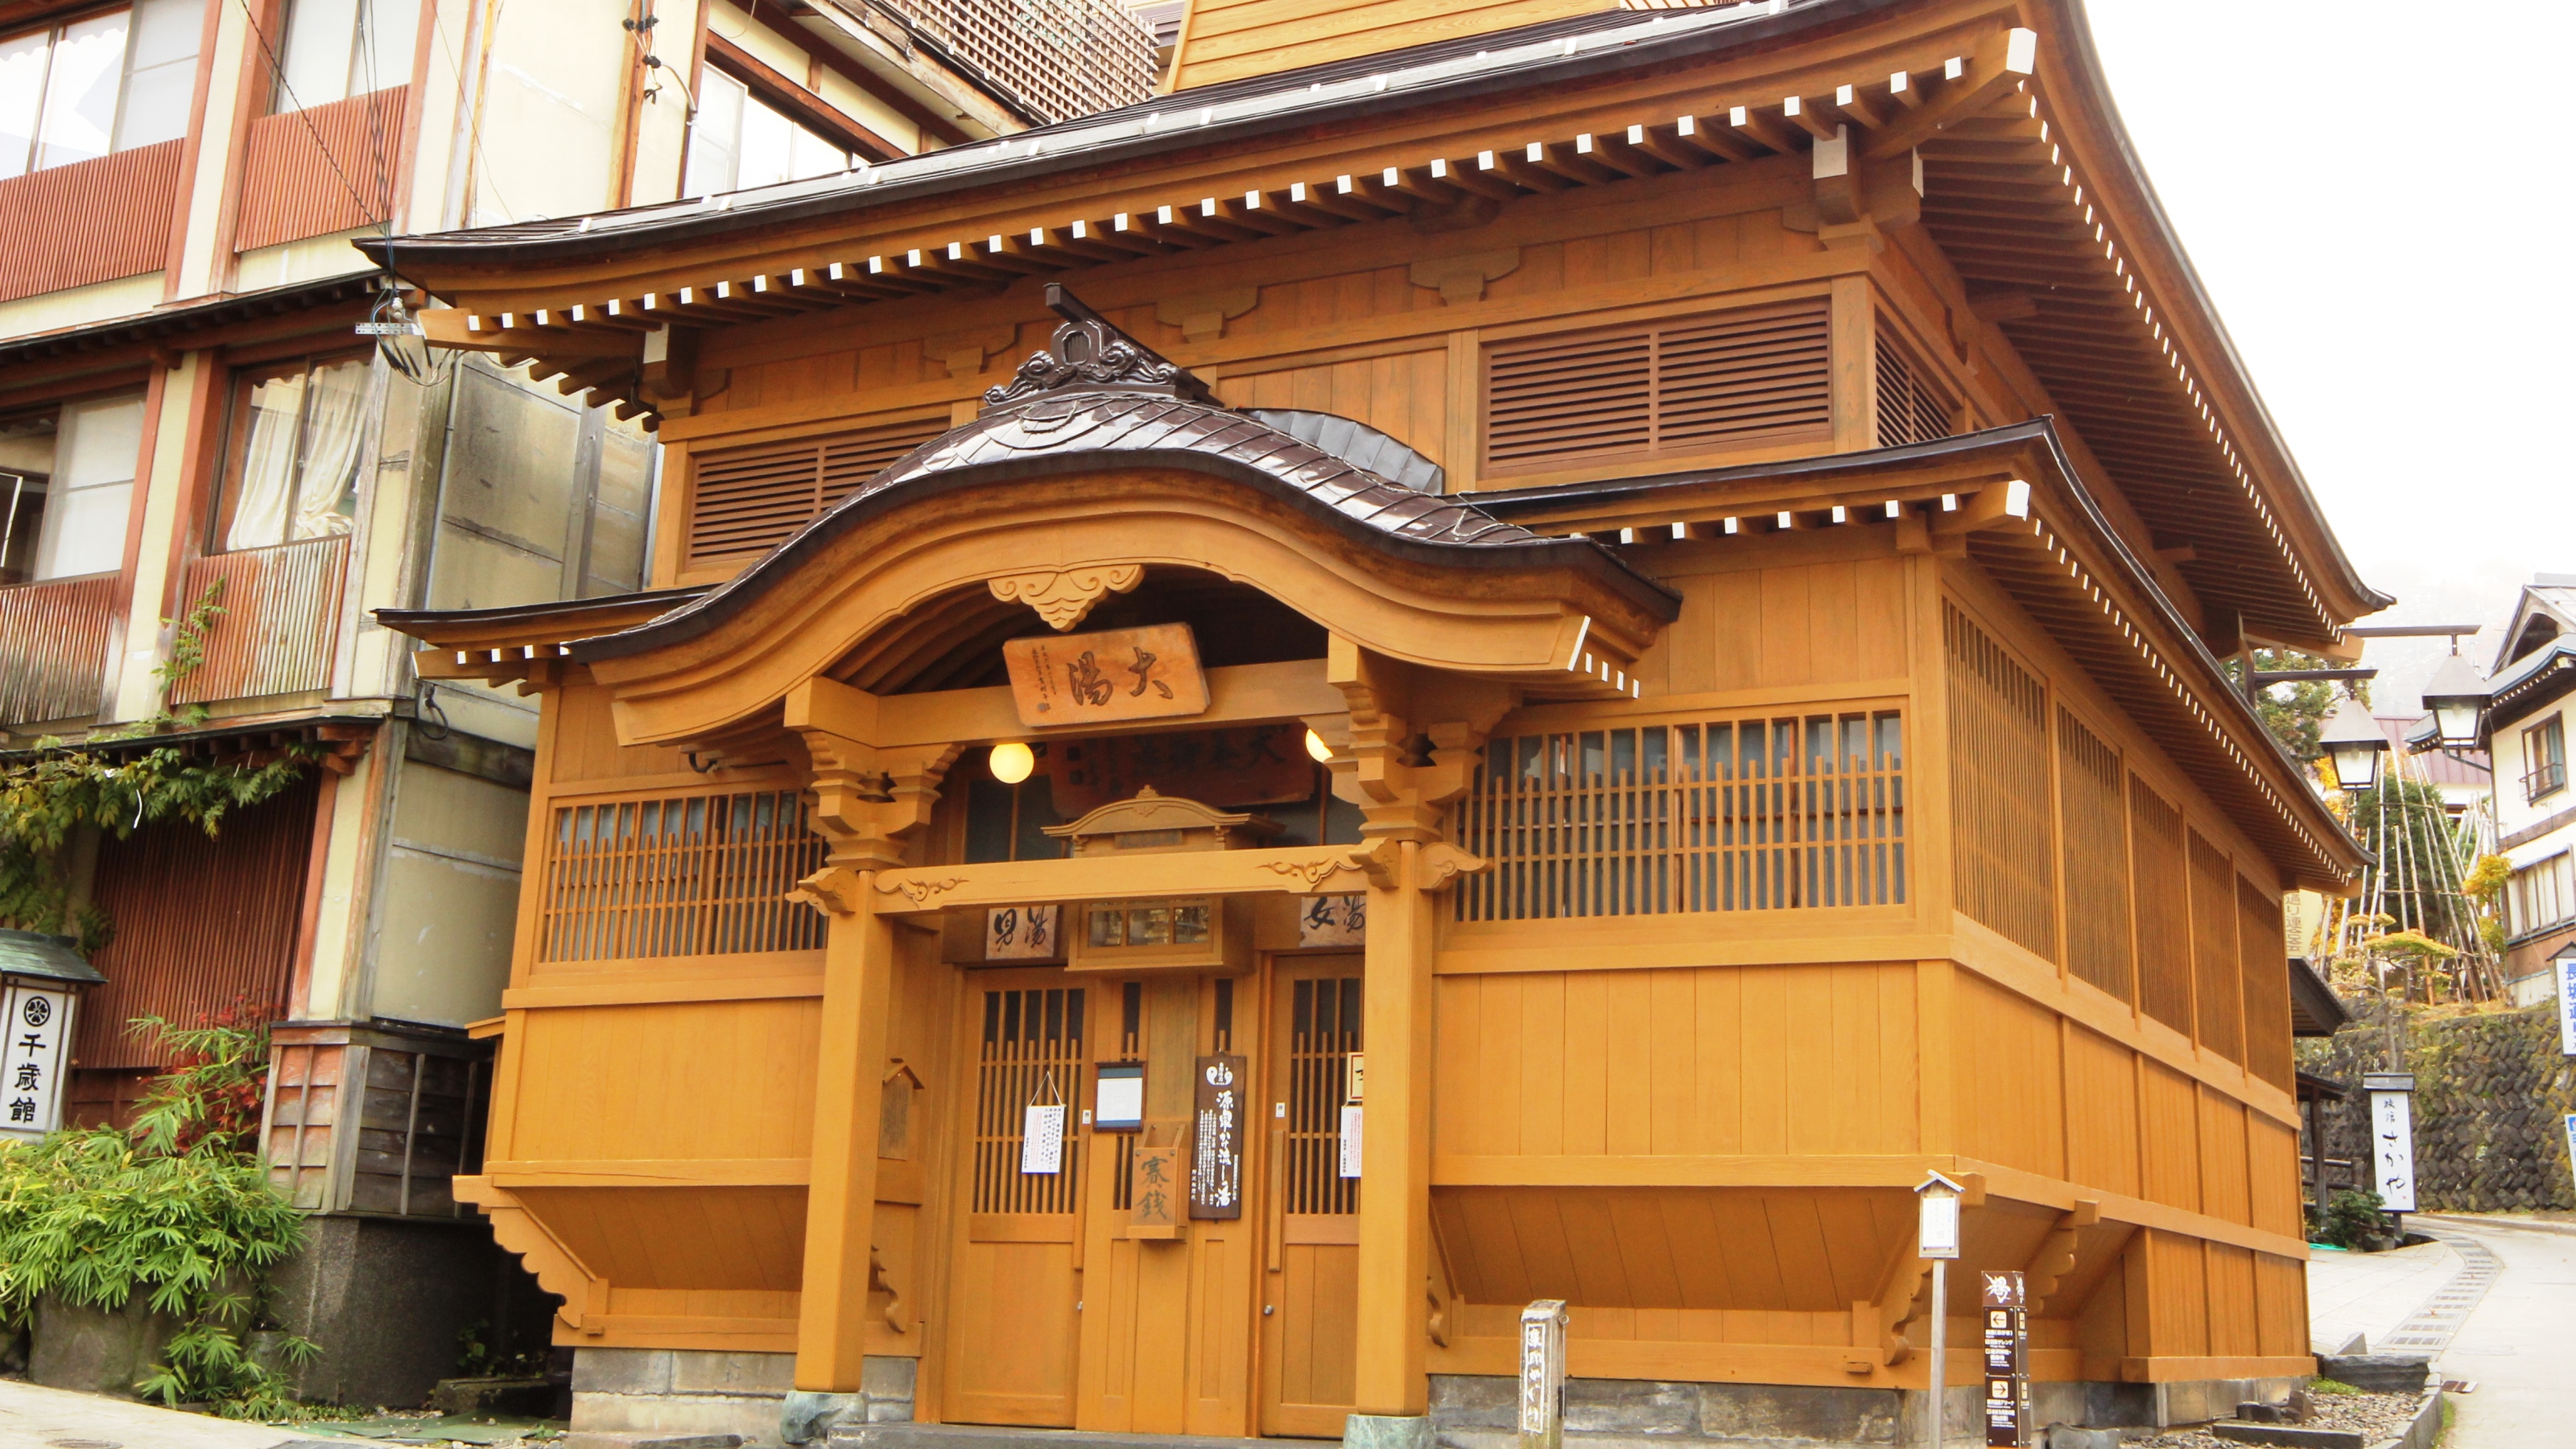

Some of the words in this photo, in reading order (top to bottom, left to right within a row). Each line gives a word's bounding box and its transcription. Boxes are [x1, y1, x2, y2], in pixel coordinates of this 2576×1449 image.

[1067, 646, 1174, 707] 大湯
[9, 1033, 46, 1125] 千歳館
[1214, 1089, 1234, 1208] 源泉かけ流しの湯
[2382, 1130, 2406, 1196] さかや
